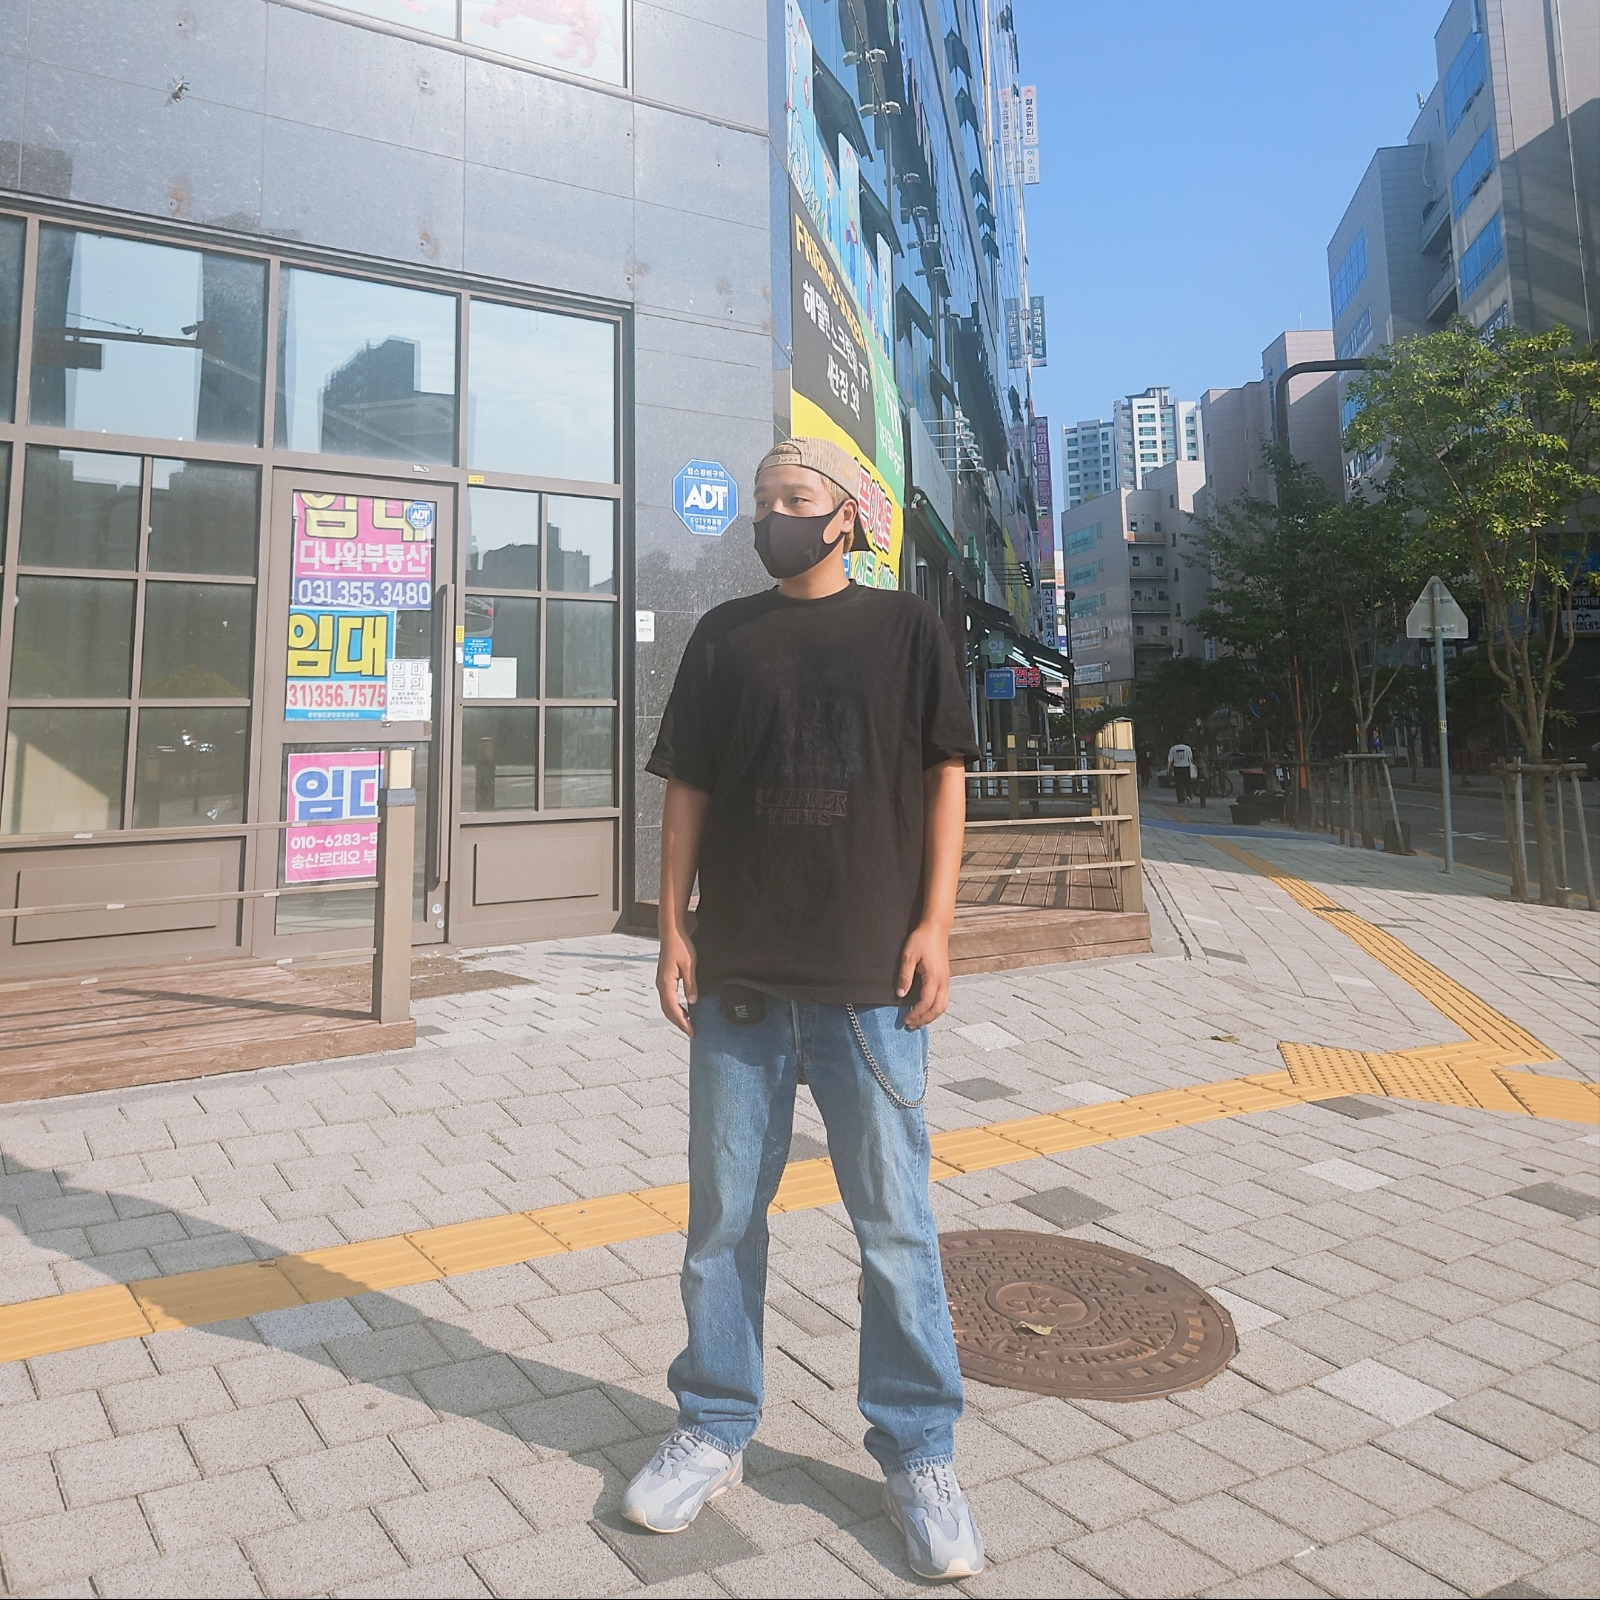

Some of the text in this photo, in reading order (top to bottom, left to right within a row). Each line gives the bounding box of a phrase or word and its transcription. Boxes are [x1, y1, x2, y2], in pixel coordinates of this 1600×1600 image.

[795, 212, 839, 306] FRIENDS
[685, 483, 728, 512] ADT
[411, 509, 430, 521] ADT
[1044, 589, 1057, 648] 시그니처독서실
[286, 613, 388, 677] 임대
[291, 850, 361, 869] 송산로데오
[1057, 1344, 1150, 1366] telecom
